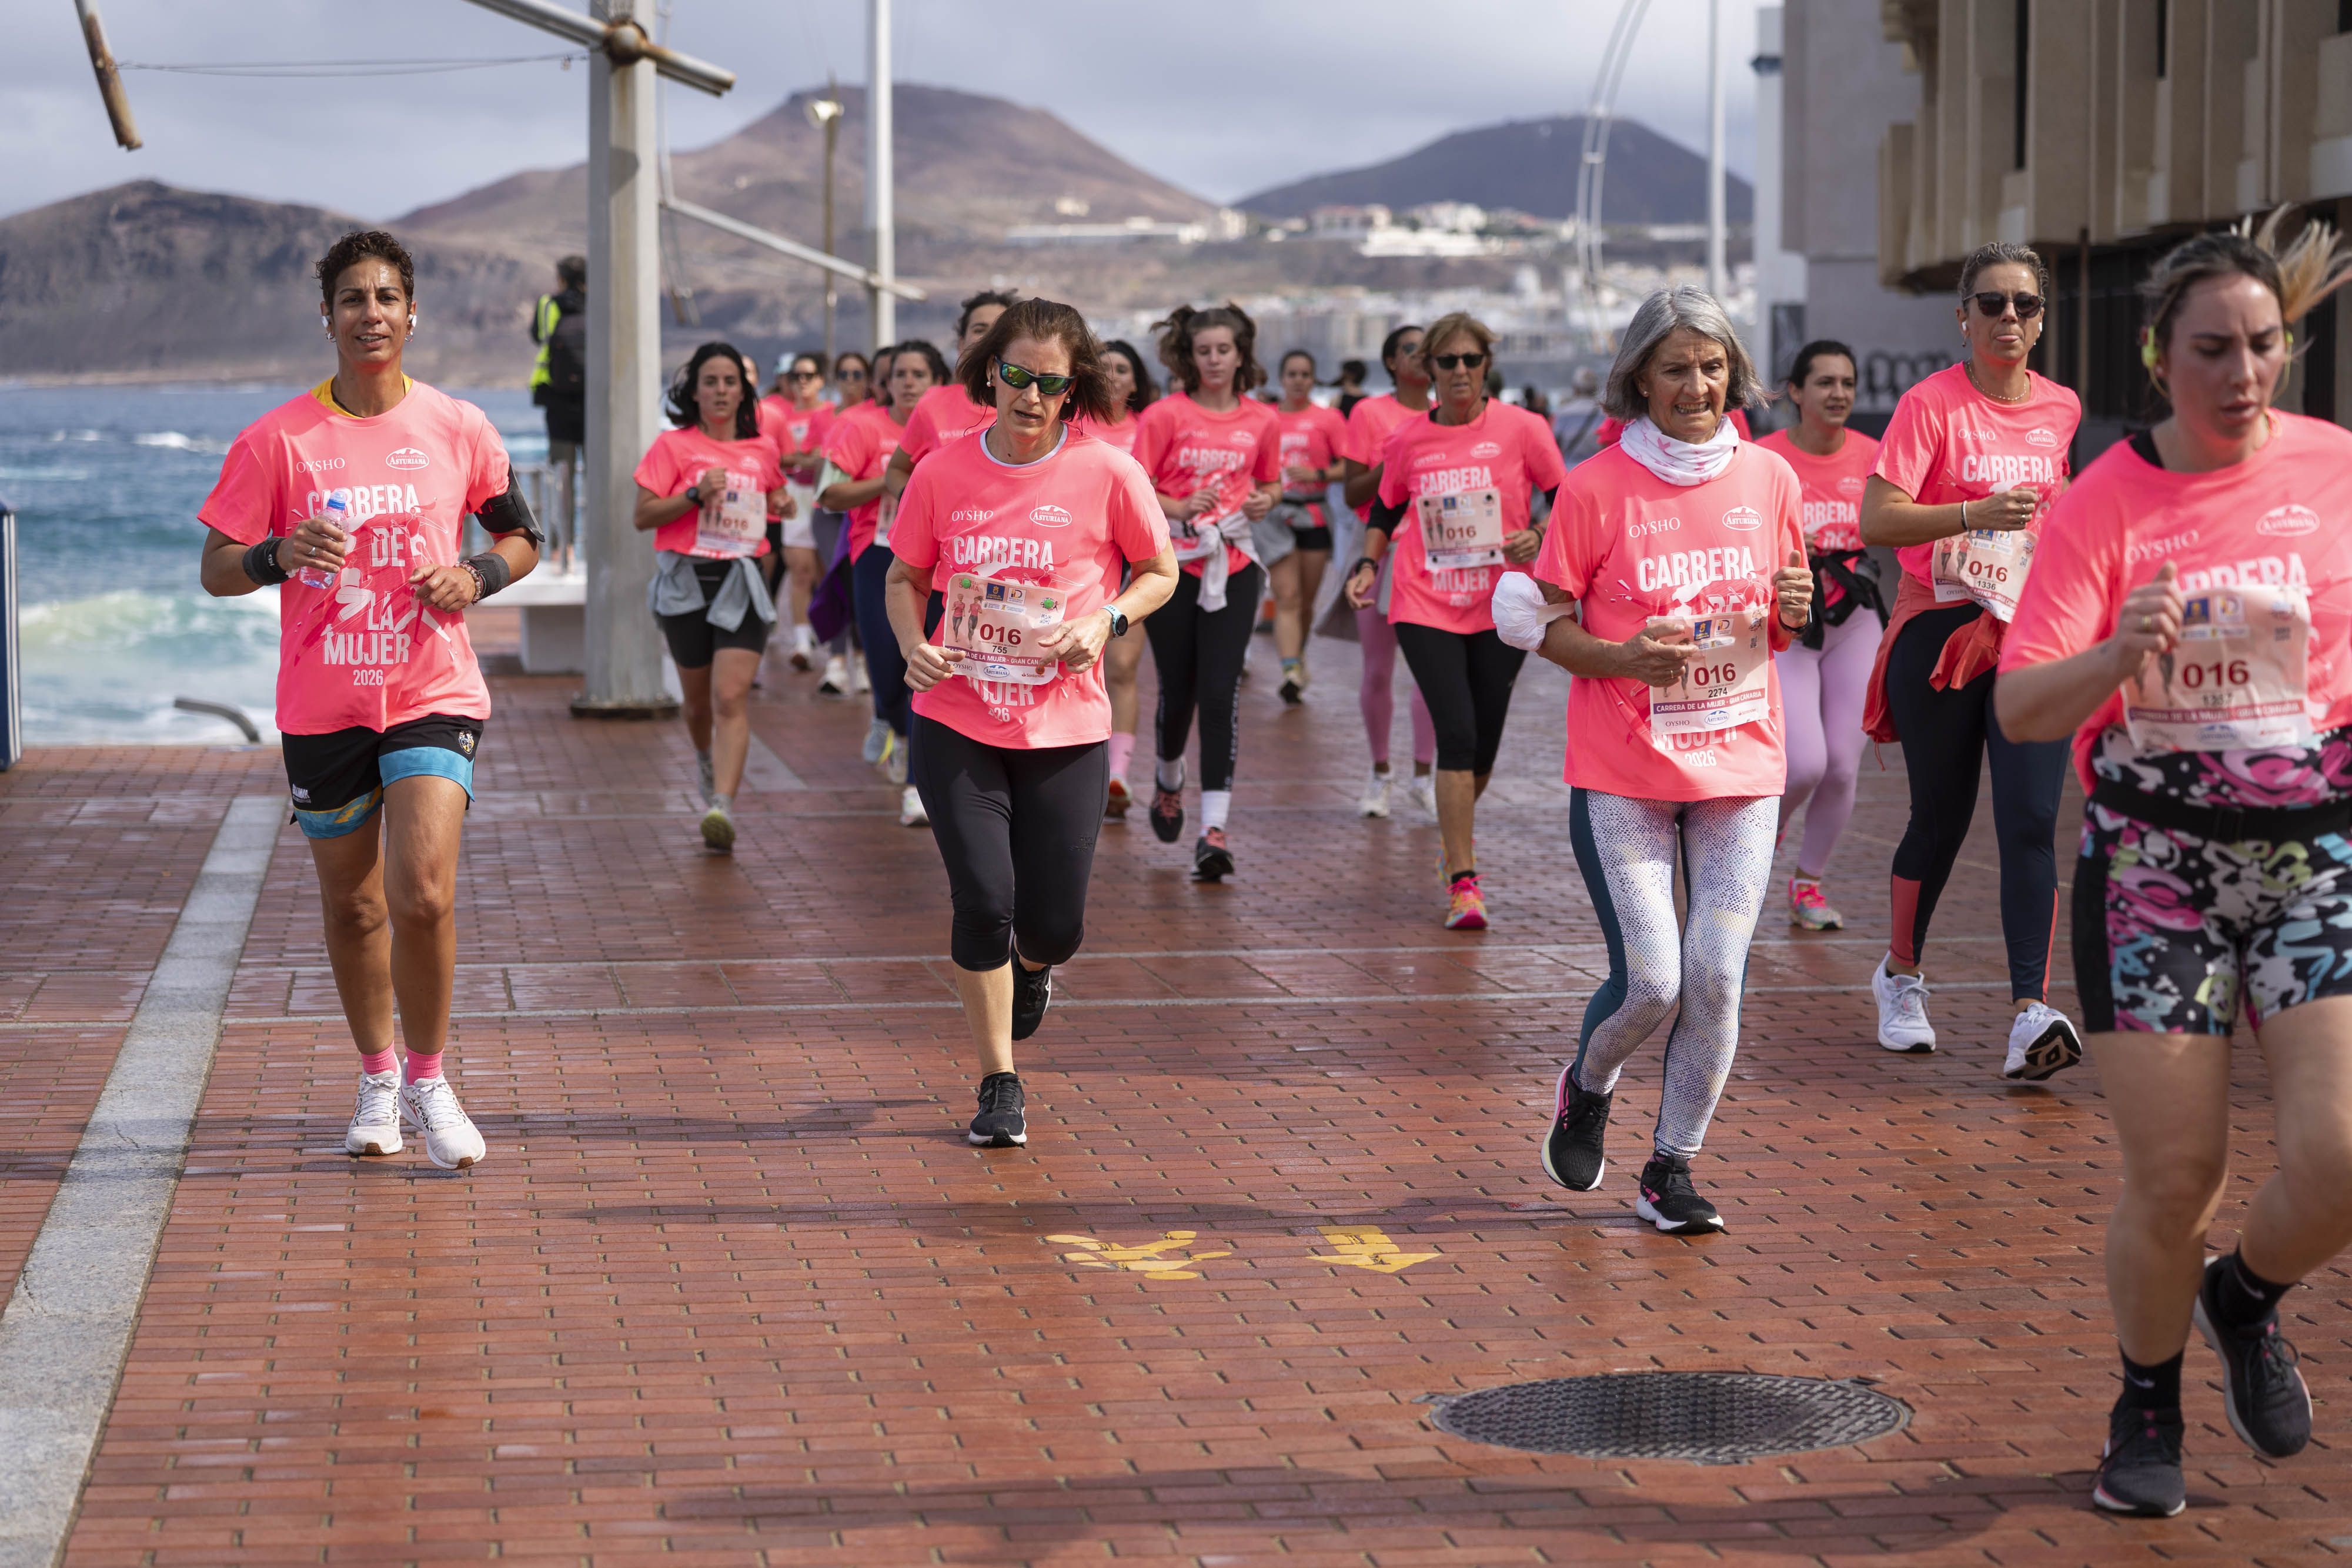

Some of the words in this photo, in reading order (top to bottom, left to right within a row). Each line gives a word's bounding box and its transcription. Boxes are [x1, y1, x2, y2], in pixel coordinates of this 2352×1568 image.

[1958, 428, 1996, 441] OYSHO
[296, 457, 346, 473] OYSHO
[389, 456, 426, 465] ASTURIANA
[1963, 454, 2054, 484] CARRERA
[1420, 466, 1493, 496] CARRERA
[951, 510, 994, 521] OYSHO
[1033, 511, 1068, 523] ASTURIANA
[1726, 515, 1760, 525] ASTURIANA
[1803, 501, 1858, 524] RRERA
[723, 517, 748, 531] 016
[1446, 525, 1476, 540] 016
[1628, 517, 1681, 538] OYSHO
[370, 526, 406, 567] DE
[952, 535, 1054, 571] CARRERA
[2124, 529, 2200, 565] OYSHO
[1638, 546, 1757, 592] CARRERA
[1969, 561, 2008, 582] 016
[1977, 580, 1996, 590] 1336
[367, 591, 395, 630] LA
[980, 623, 1021, 645] 016
[323, 632, 411, 666] MUJER
[992, 645, 1007, 654] 755
[353, 669, 383, 686] 2026
[953, 663, 973, 671] OYSHO
[1694, 663, 1736, 686] 016
[2183, 660, 2250, 688] 016
[968, 677, 1035, 706] UJER
[1656, 704, 1686, 712] CARRERA
[1729, 696, 1740, 705] GRAN
[1740, 691, 1762, 701] CANARIA
[1708, 687, 1728, 698] 2274
[1685, 750, 1717, 767] 2026
